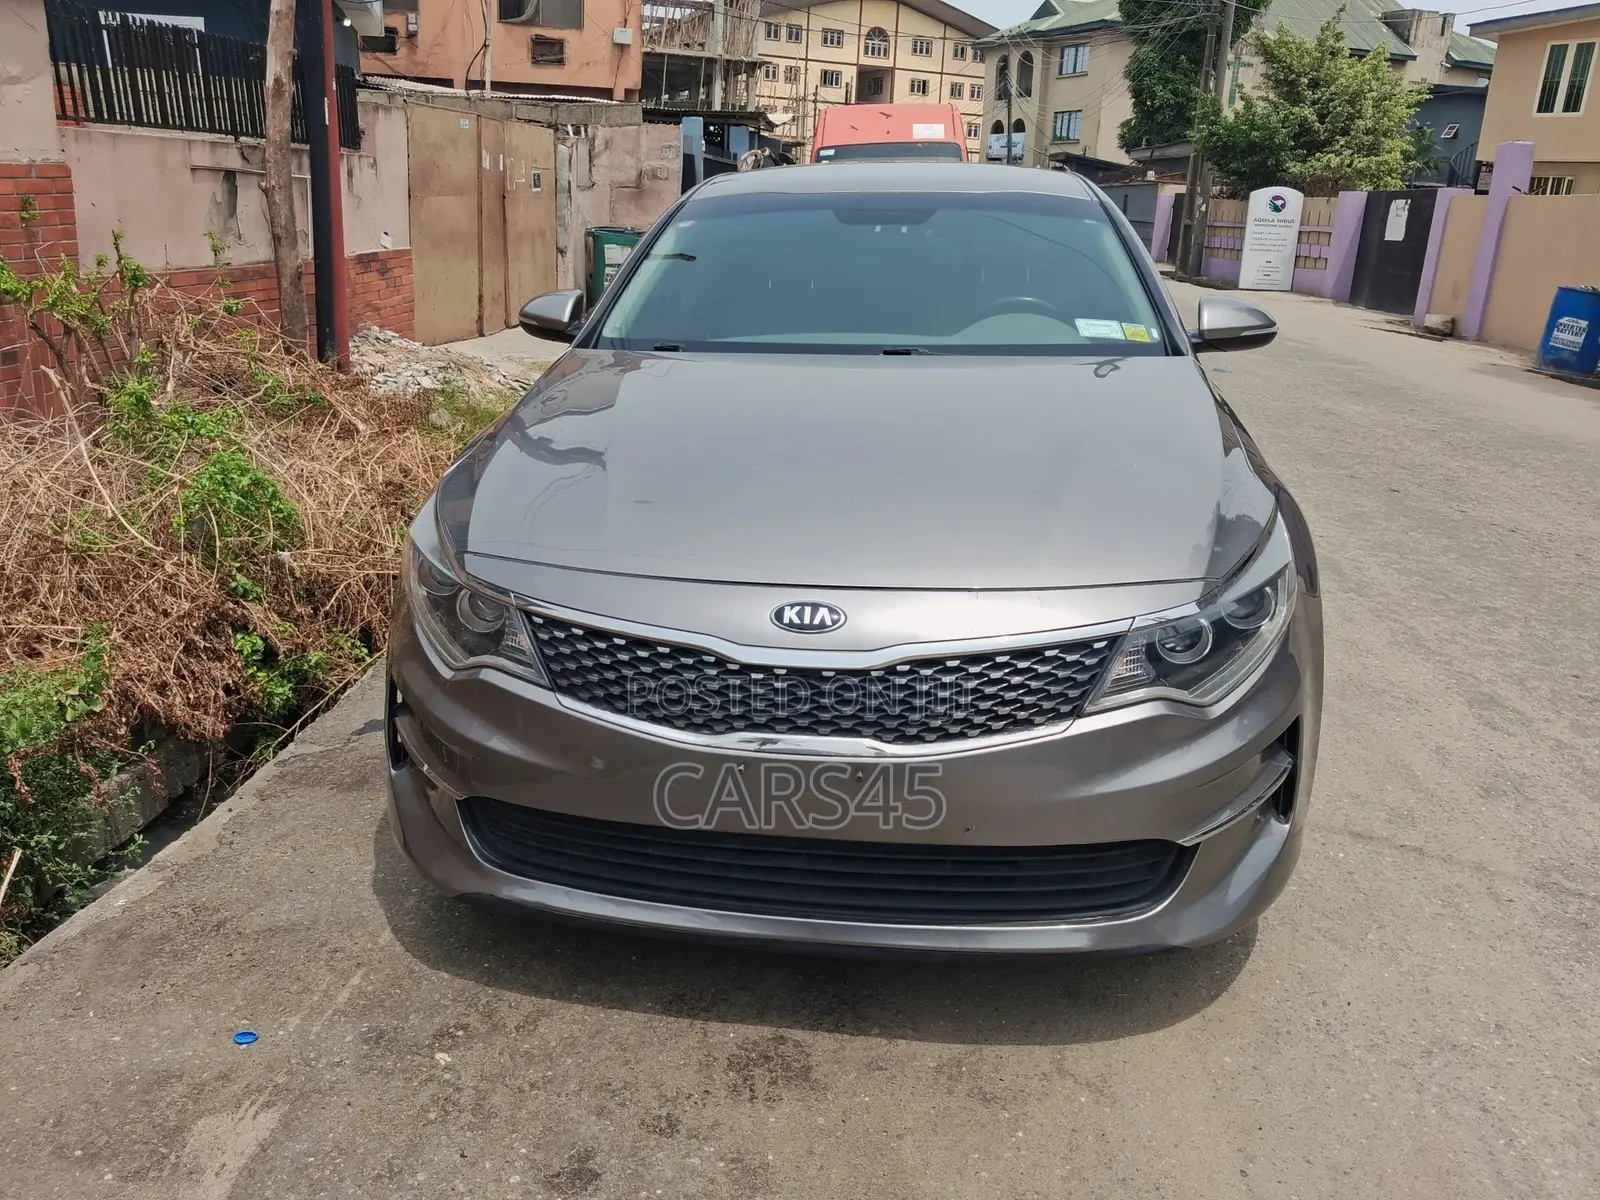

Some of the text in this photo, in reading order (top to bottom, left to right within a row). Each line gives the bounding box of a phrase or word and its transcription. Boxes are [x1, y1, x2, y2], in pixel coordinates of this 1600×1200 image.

[1556, 321, 1588, 333] INVERTER
[1556, 327, 1584, 338] BATTERY
[783, 605, 832, 626] KIA
